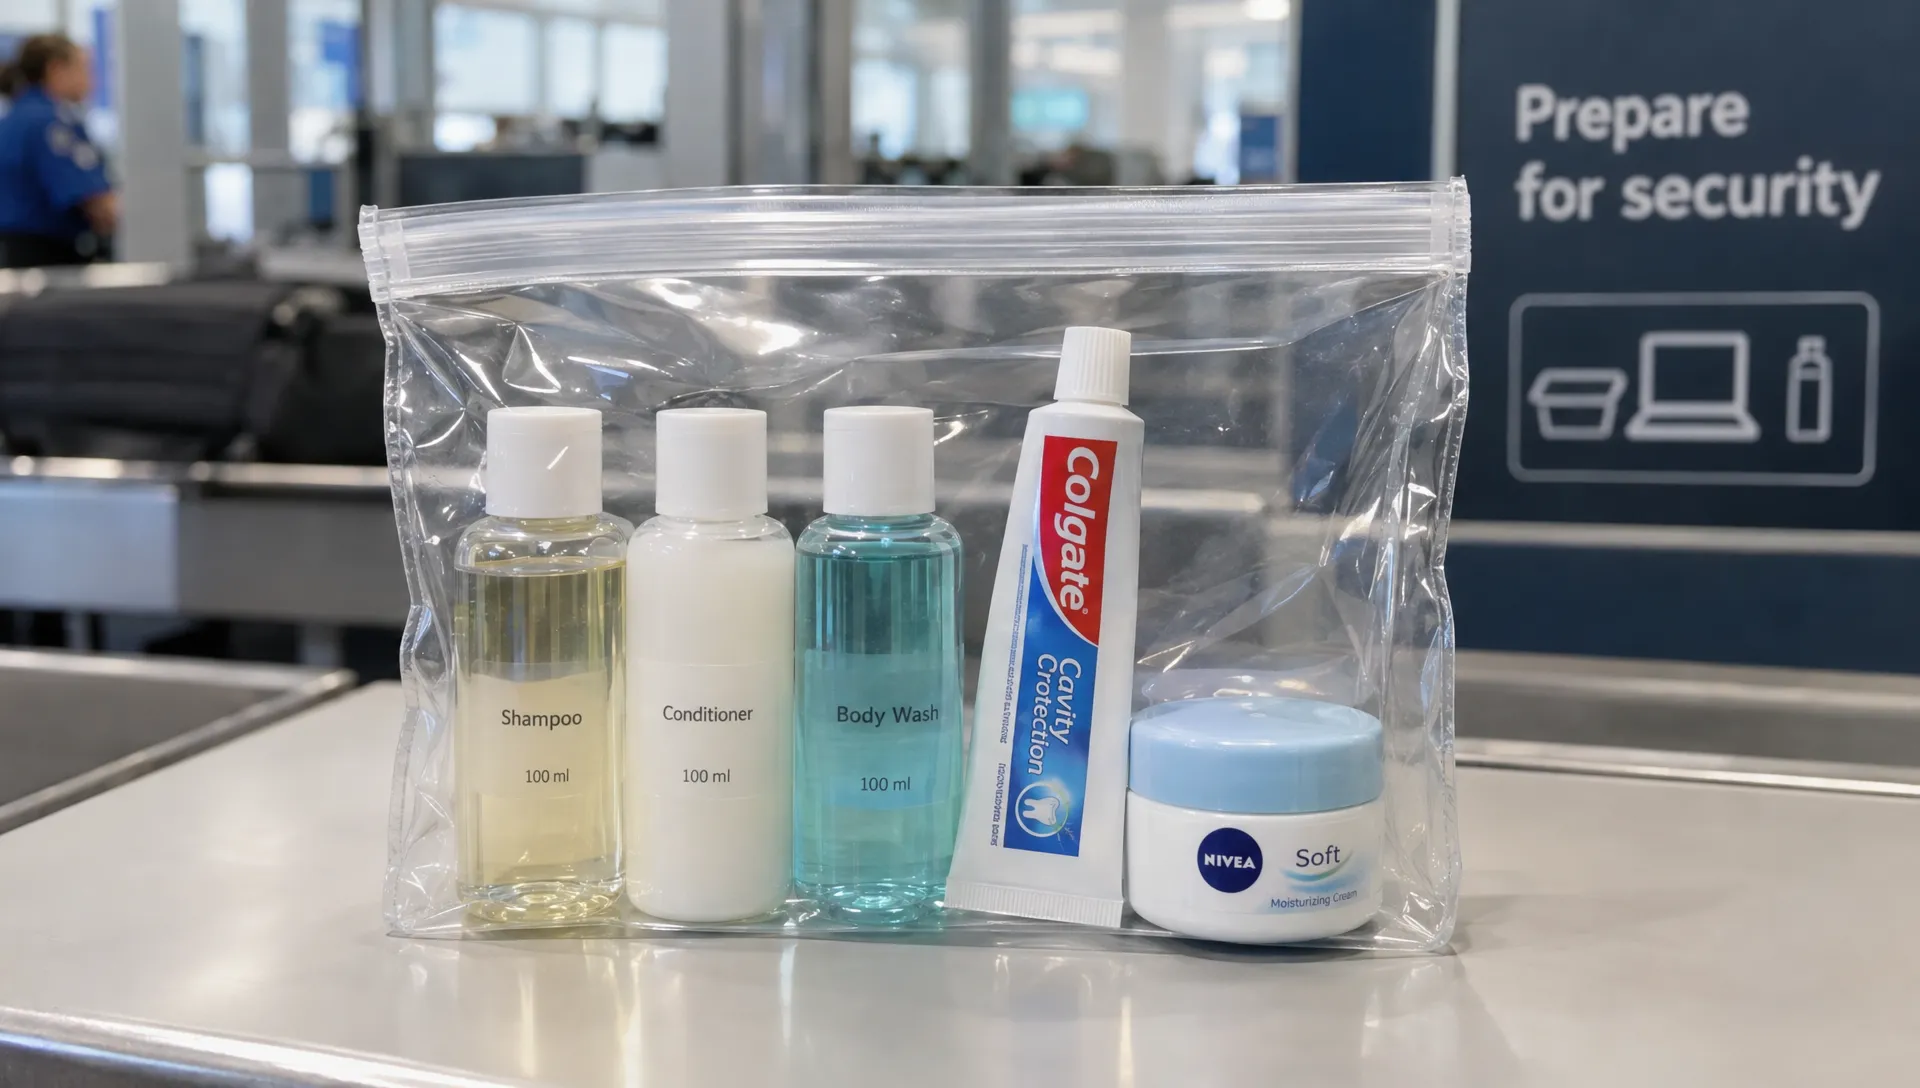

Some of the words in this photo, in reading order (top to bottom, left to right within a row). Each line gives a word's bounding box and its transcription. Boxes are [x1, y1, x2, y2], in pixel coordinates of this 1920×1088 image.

[1516, 84, 1750, 153] Prepare
[1515, 161, 1605, 221] for
[1620, 155, 1881, 231] security
[1053, 446, 1099, 611] Colgate
[1048, 657, 1082, 745] Cavity
[501, 709, 582, 730] Shampoo
[662, 705, 753, 723] Conditioner
[836, 705, 885, 728] Body
[892, 704, 939, 724] Wash
[1028, 653, 1058, 775] Crotection
[525, 769, 549, 783] 100
[553, 768, 570, 783] ml
[682, 769, 708, 783] 100
[712, 768, 731, 783] ml
[860, 776, 888, 792] 100
[893, 775, 911, 791] ml
[1204, 853, 1256, 869] NIVEA
[1296, 845, 1341, 867] Soft
[1270, 896, 1331, 909] Moisturizing
[1332, 889, 1358, 903] Cream
